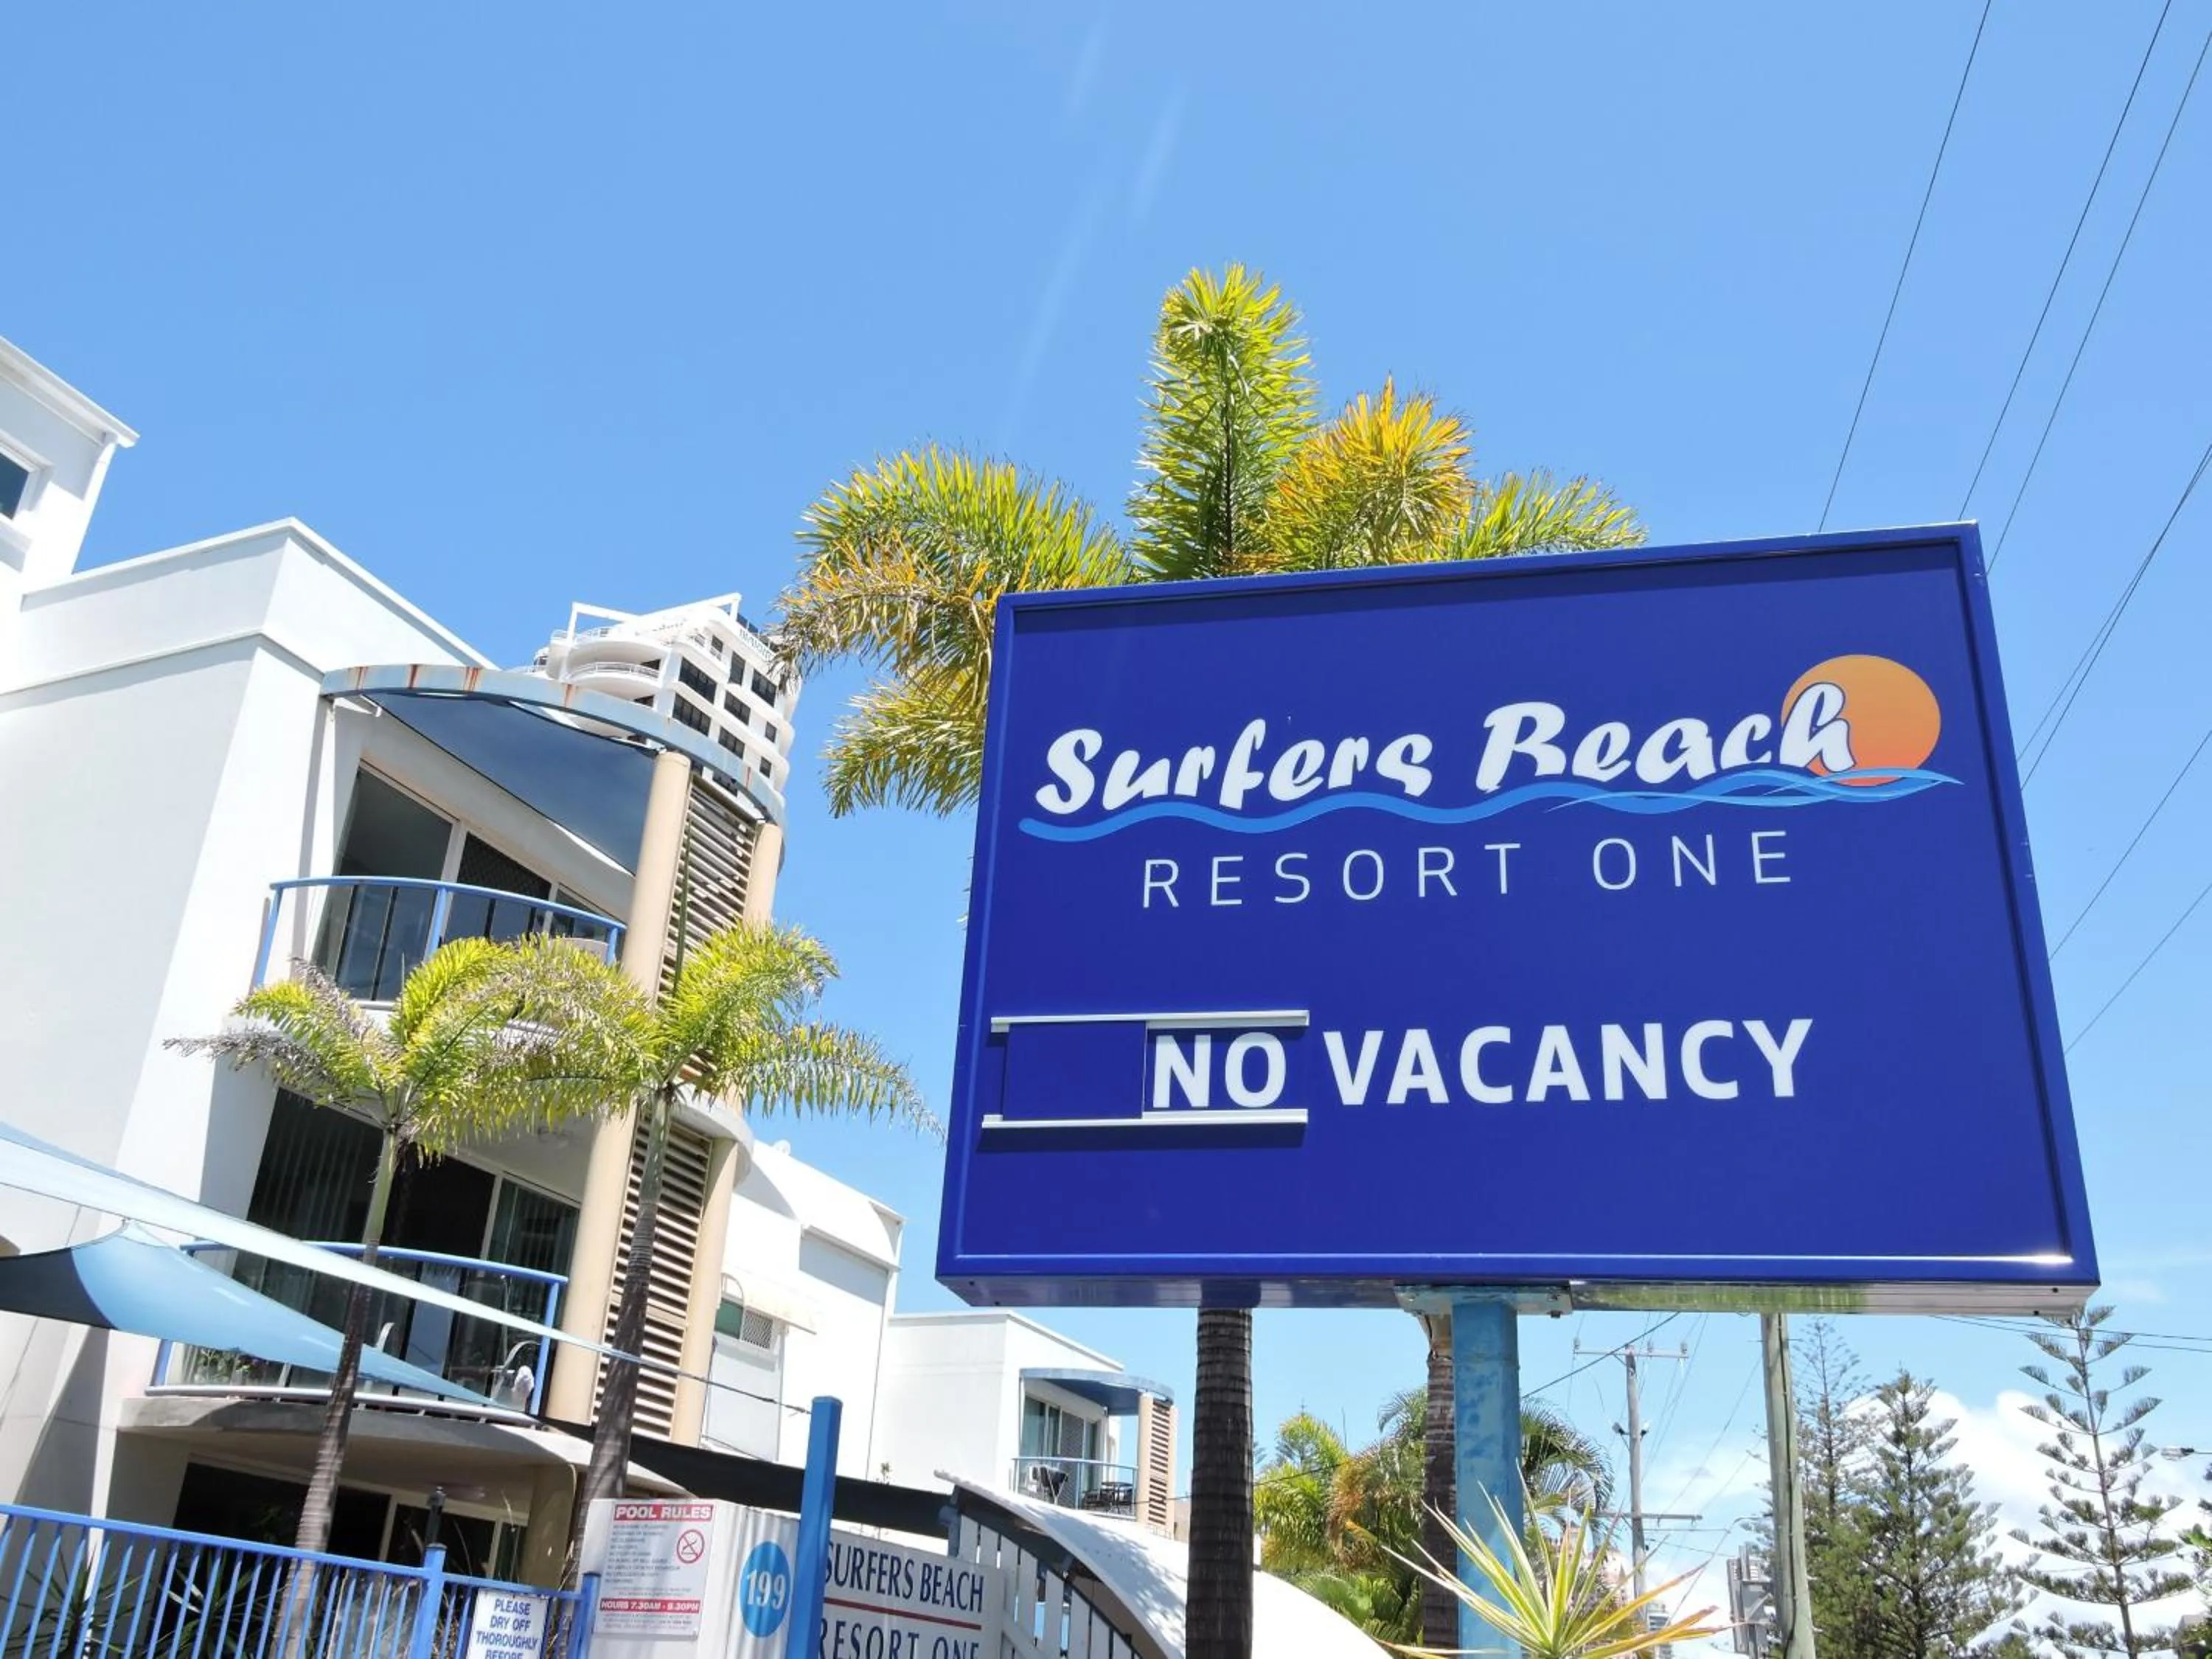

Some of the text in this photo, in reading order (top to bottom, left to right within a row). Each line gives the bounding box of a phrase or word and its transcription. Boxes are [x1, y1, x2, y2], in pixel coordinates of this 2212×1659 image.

[1036, 681, 1856, 814] Surfers Beach
[1143, 831, 1792, 908] RESORT ONE
[1151, 1018, 1814, 1109] NO VACANCY
[616, 1506, 712, 1519] POOL RULES
[494, 1599, 532, 1615] PLEASE
[746, 1569, 786, 1610] 199
[919, 1562, 984, 1613] BEACH
[476, 1630, 539, 1649] THOROUGHLY
[490, 1615, 531, 1632] DRY OFF
